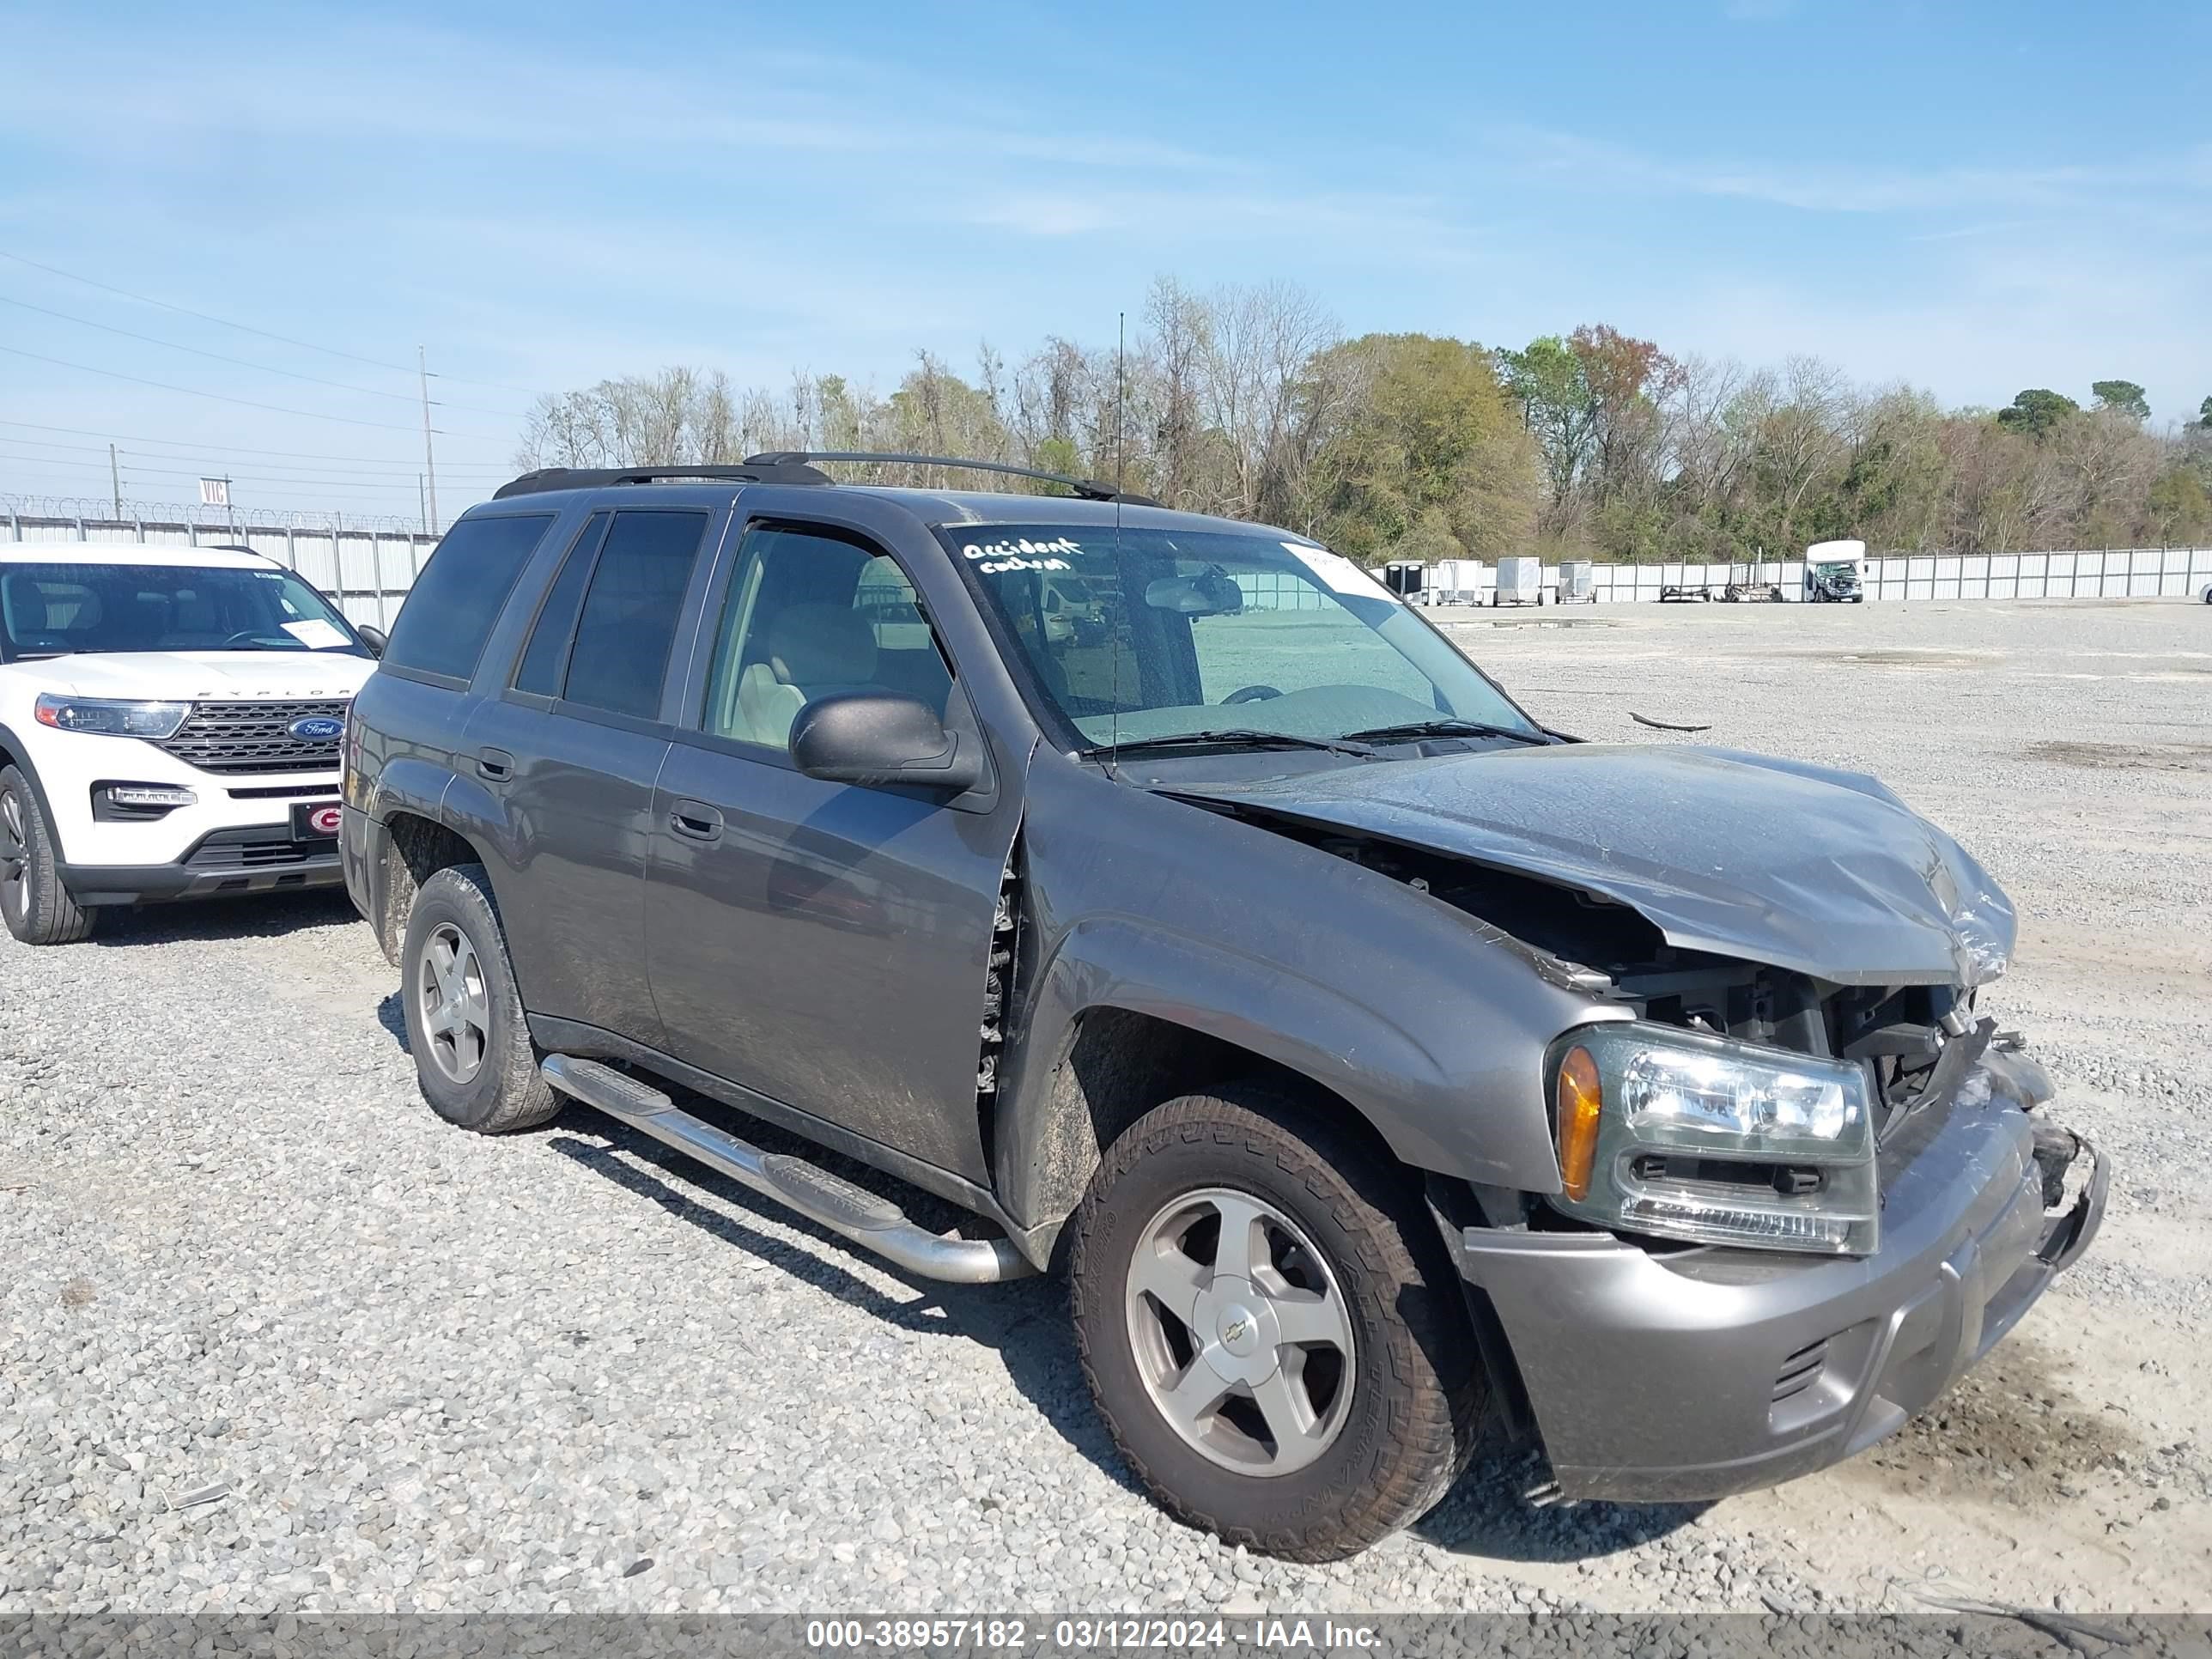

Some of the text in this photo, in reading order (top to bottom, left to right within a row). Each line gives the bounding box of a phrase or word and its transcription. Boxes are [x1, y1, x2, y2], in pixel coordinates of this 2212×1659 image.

[963, 538, 1085, 559] accident
[304, 722, 335, 736] Ford
[1340, 1257, 1379, 1343] ALL
